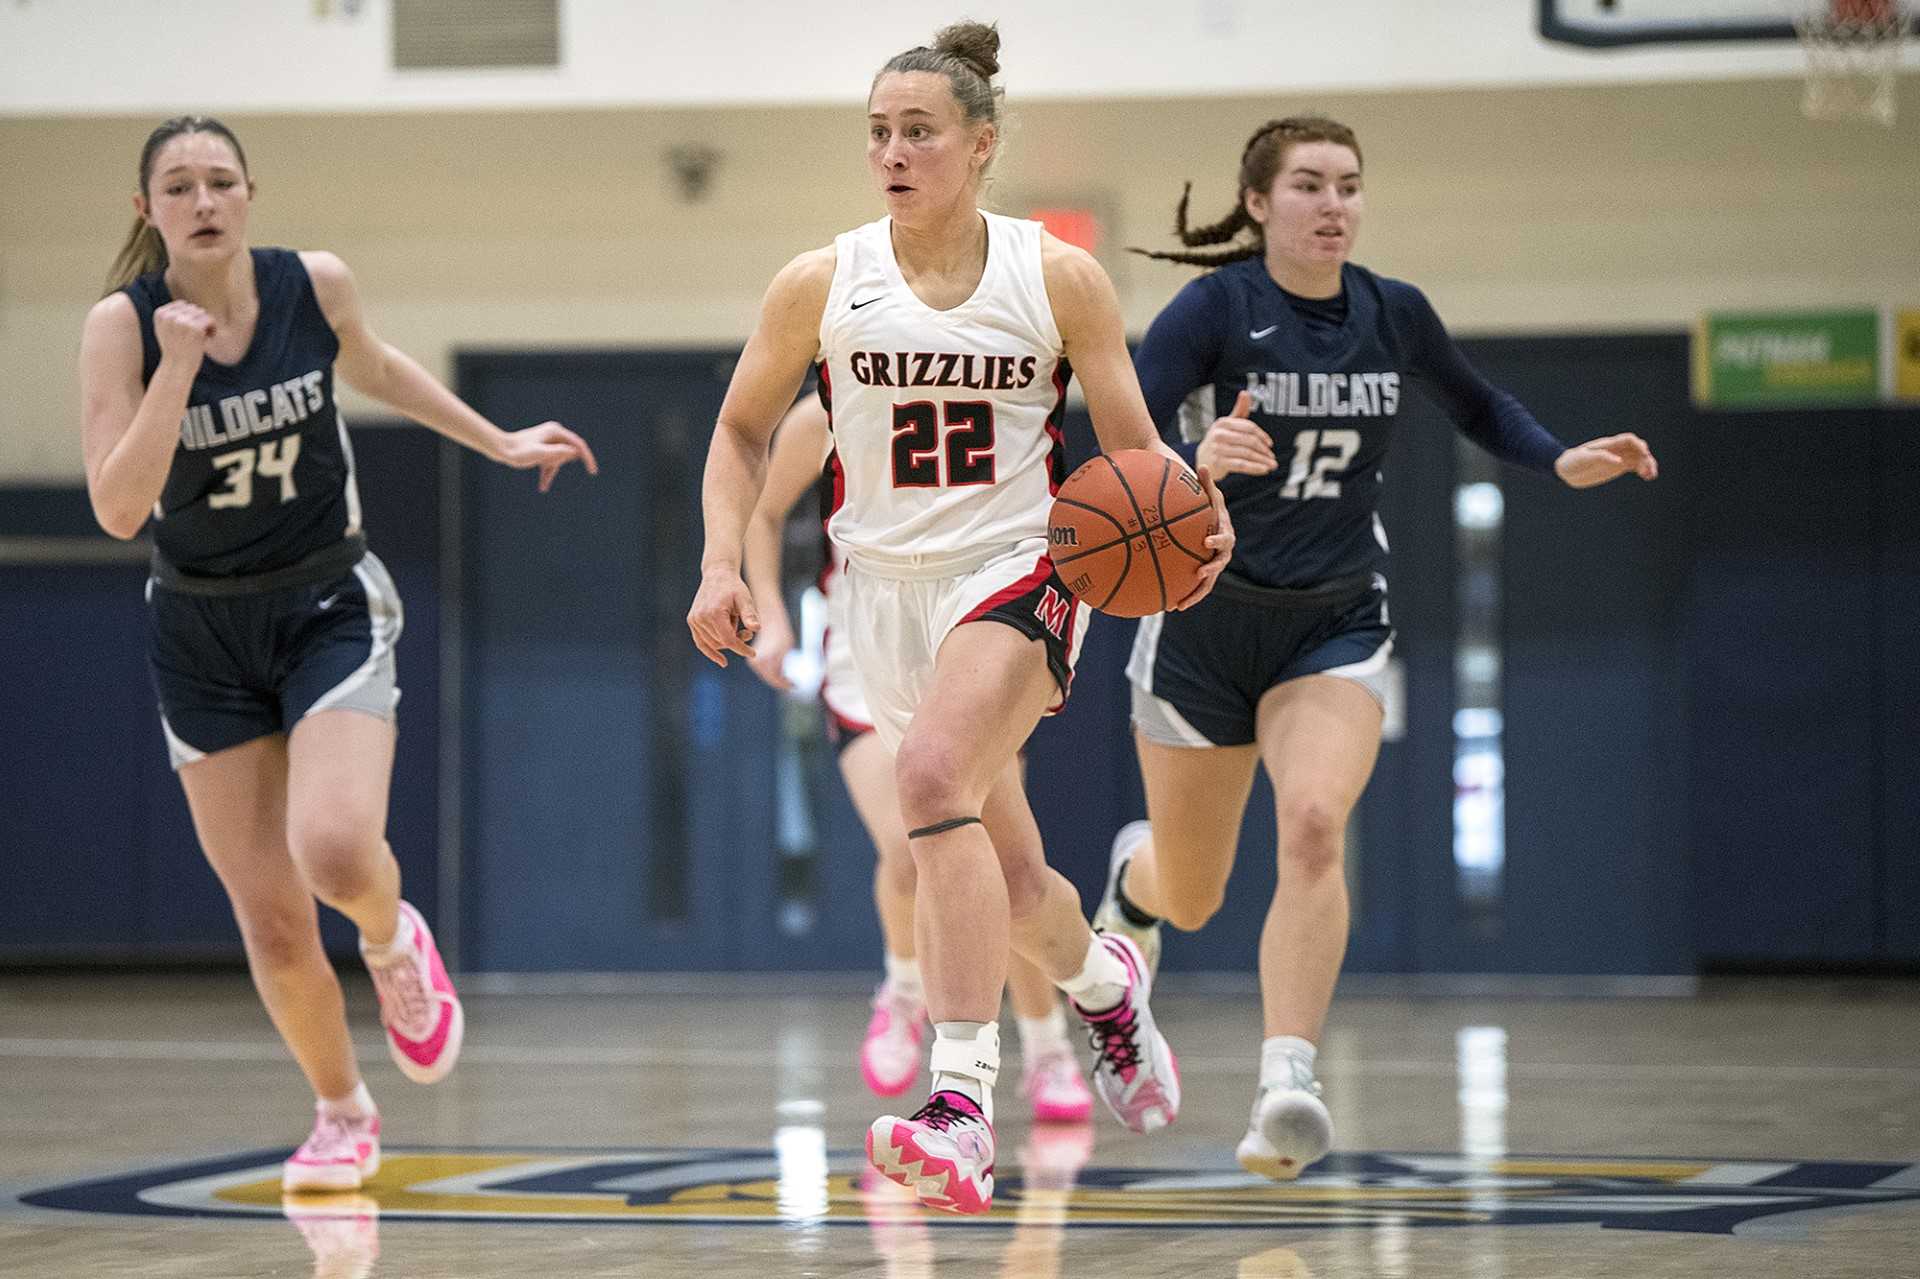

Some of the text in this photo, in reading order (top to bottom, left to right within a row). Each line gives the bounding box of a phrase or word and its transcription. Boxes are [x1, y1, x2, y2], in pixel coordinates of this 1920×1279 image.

[850, 351, 1037, 390] GRIZZLIES
[1247, 371, 1400, 417] WILDCATS
[208, 432, 301, 510] 34
[891, 400, 996, 489] 22
[1279, 429, 1361, 501] 12
[1150, 531, 1171, 551] 24
[1034, 585, 1070, 640] M
